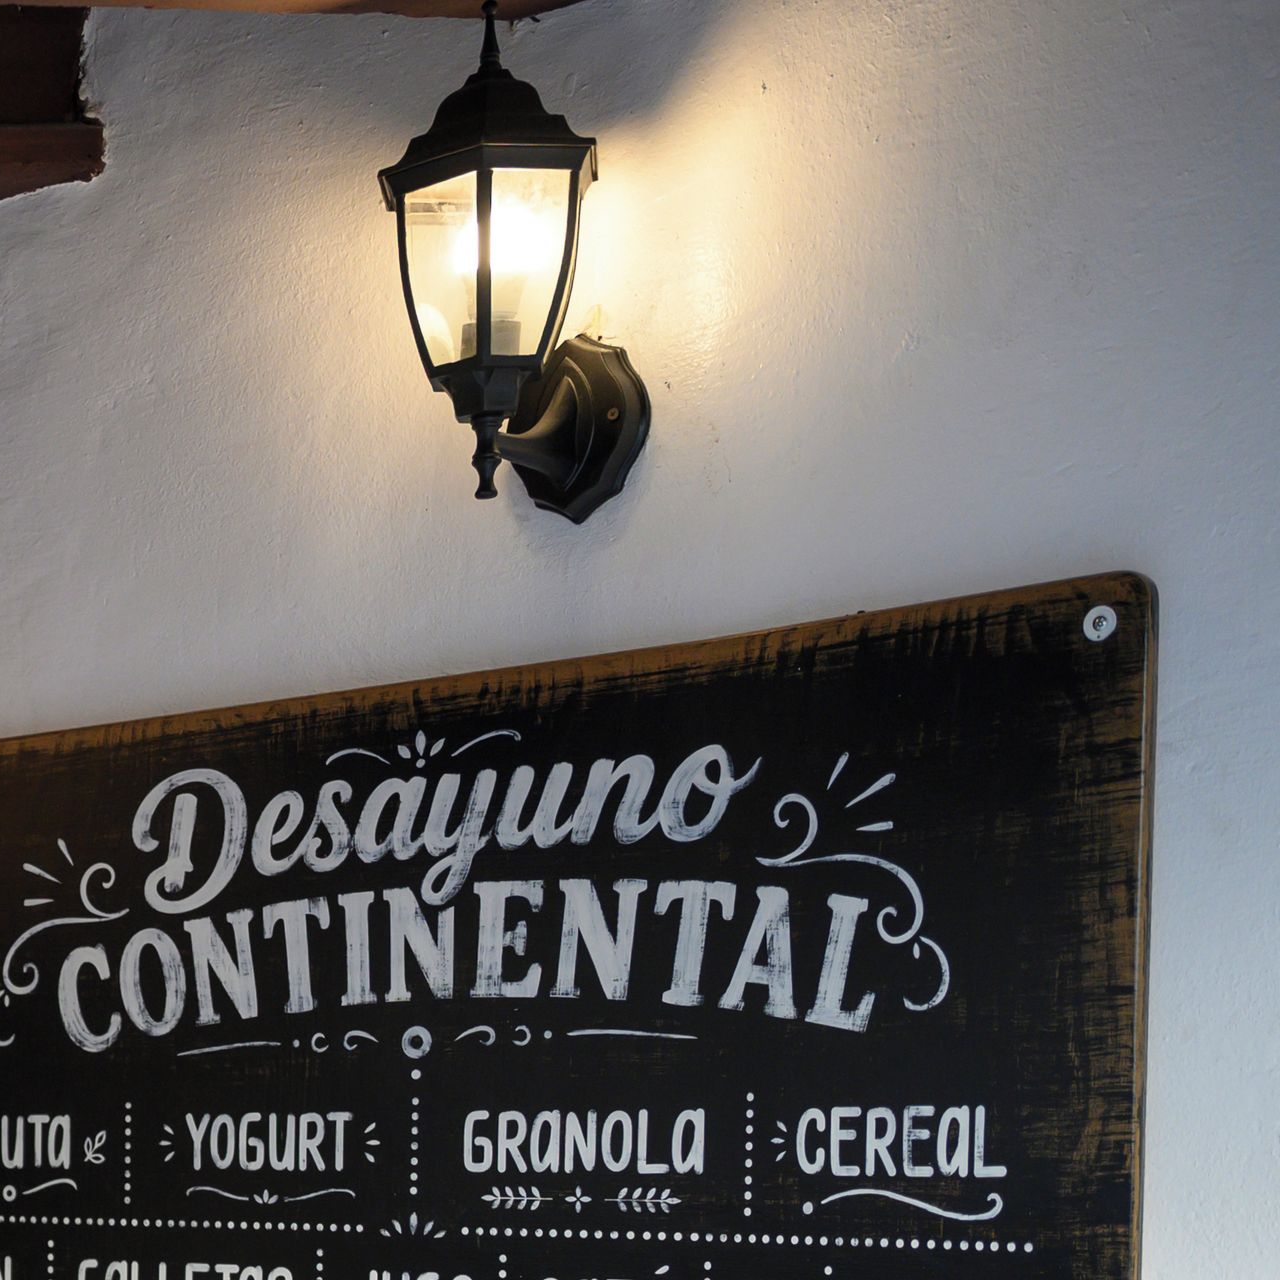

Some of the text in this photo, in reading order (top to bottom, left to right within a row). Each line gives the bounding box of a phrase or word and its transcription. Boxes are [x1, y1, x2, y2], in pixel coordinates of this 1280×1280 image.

[131, 742, 763, 914] Desayuno
[57, 876, 880, 1053] CONTINENTAL
[184, 1110, 352, 1172] YOGURT
[462, 1107, 705, 1176] GRANOLA
[795, 1104, 1007, 1179] CEREAL
